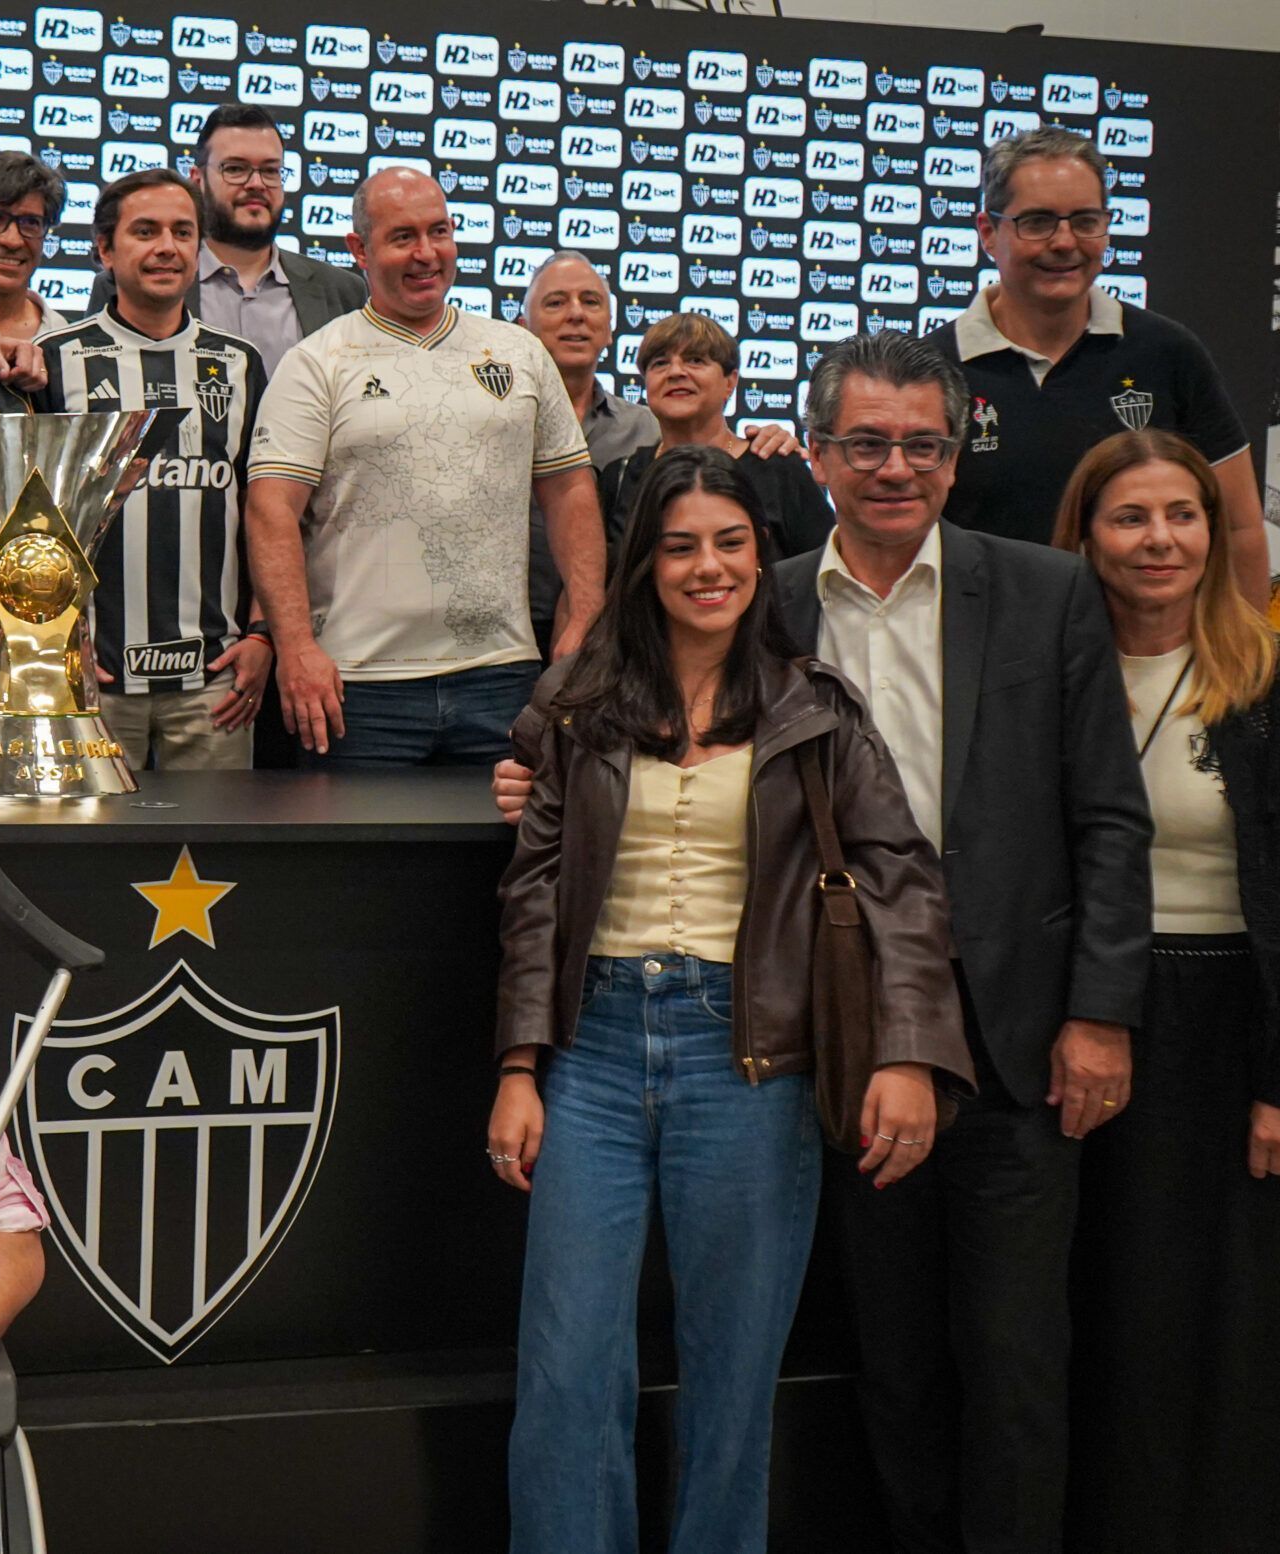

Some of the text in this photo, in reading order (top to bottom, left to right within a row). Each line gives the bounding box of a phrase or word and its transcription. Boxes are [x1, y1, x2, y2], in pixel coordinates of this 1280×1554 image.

[199, 385, 230, 395] CAM
[135, 452, 232, 489] tano
[128, 646, 196, 672] Vilma
[67, 1048, 287, 1110] CAM
